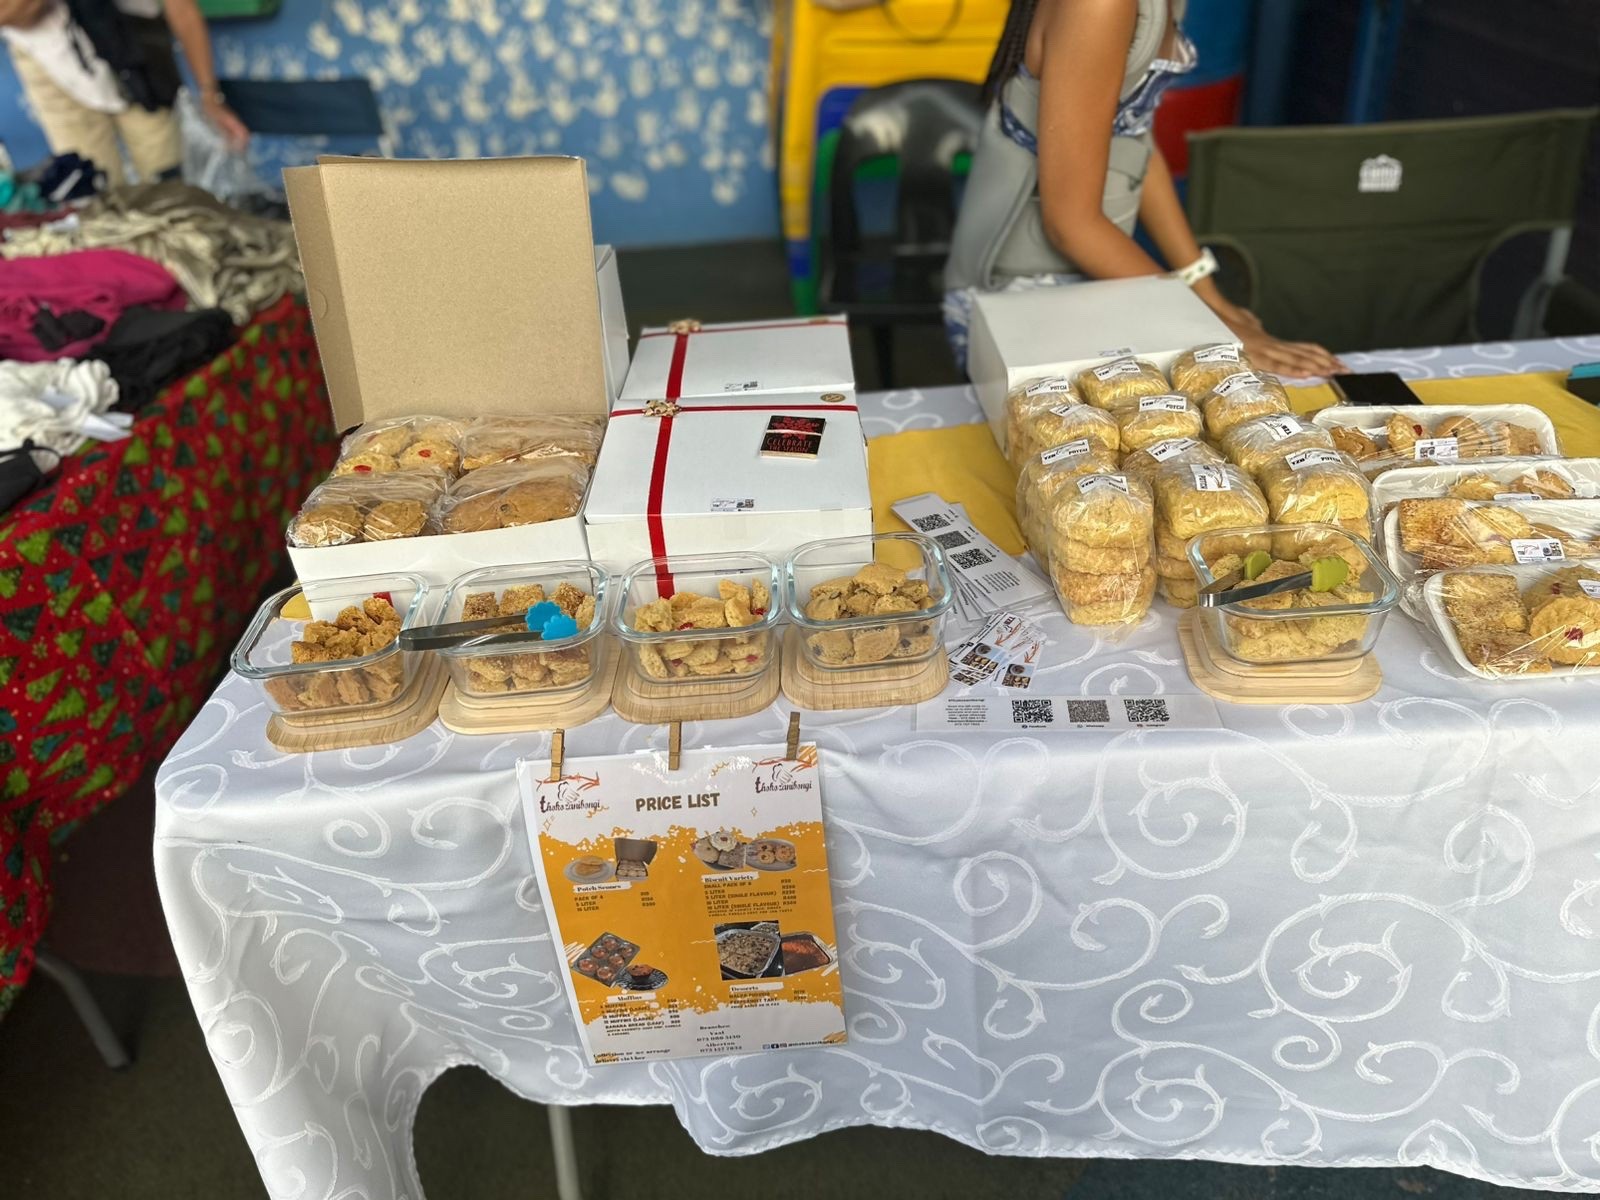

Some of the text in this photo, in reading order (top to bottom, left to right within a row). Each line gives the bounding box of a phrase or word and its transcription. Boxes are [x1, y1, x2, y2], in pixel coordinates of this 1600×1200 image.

[767, 438, 812, 446] CELEBRATE
[636, 793, 720, 812] PRICE LIST
